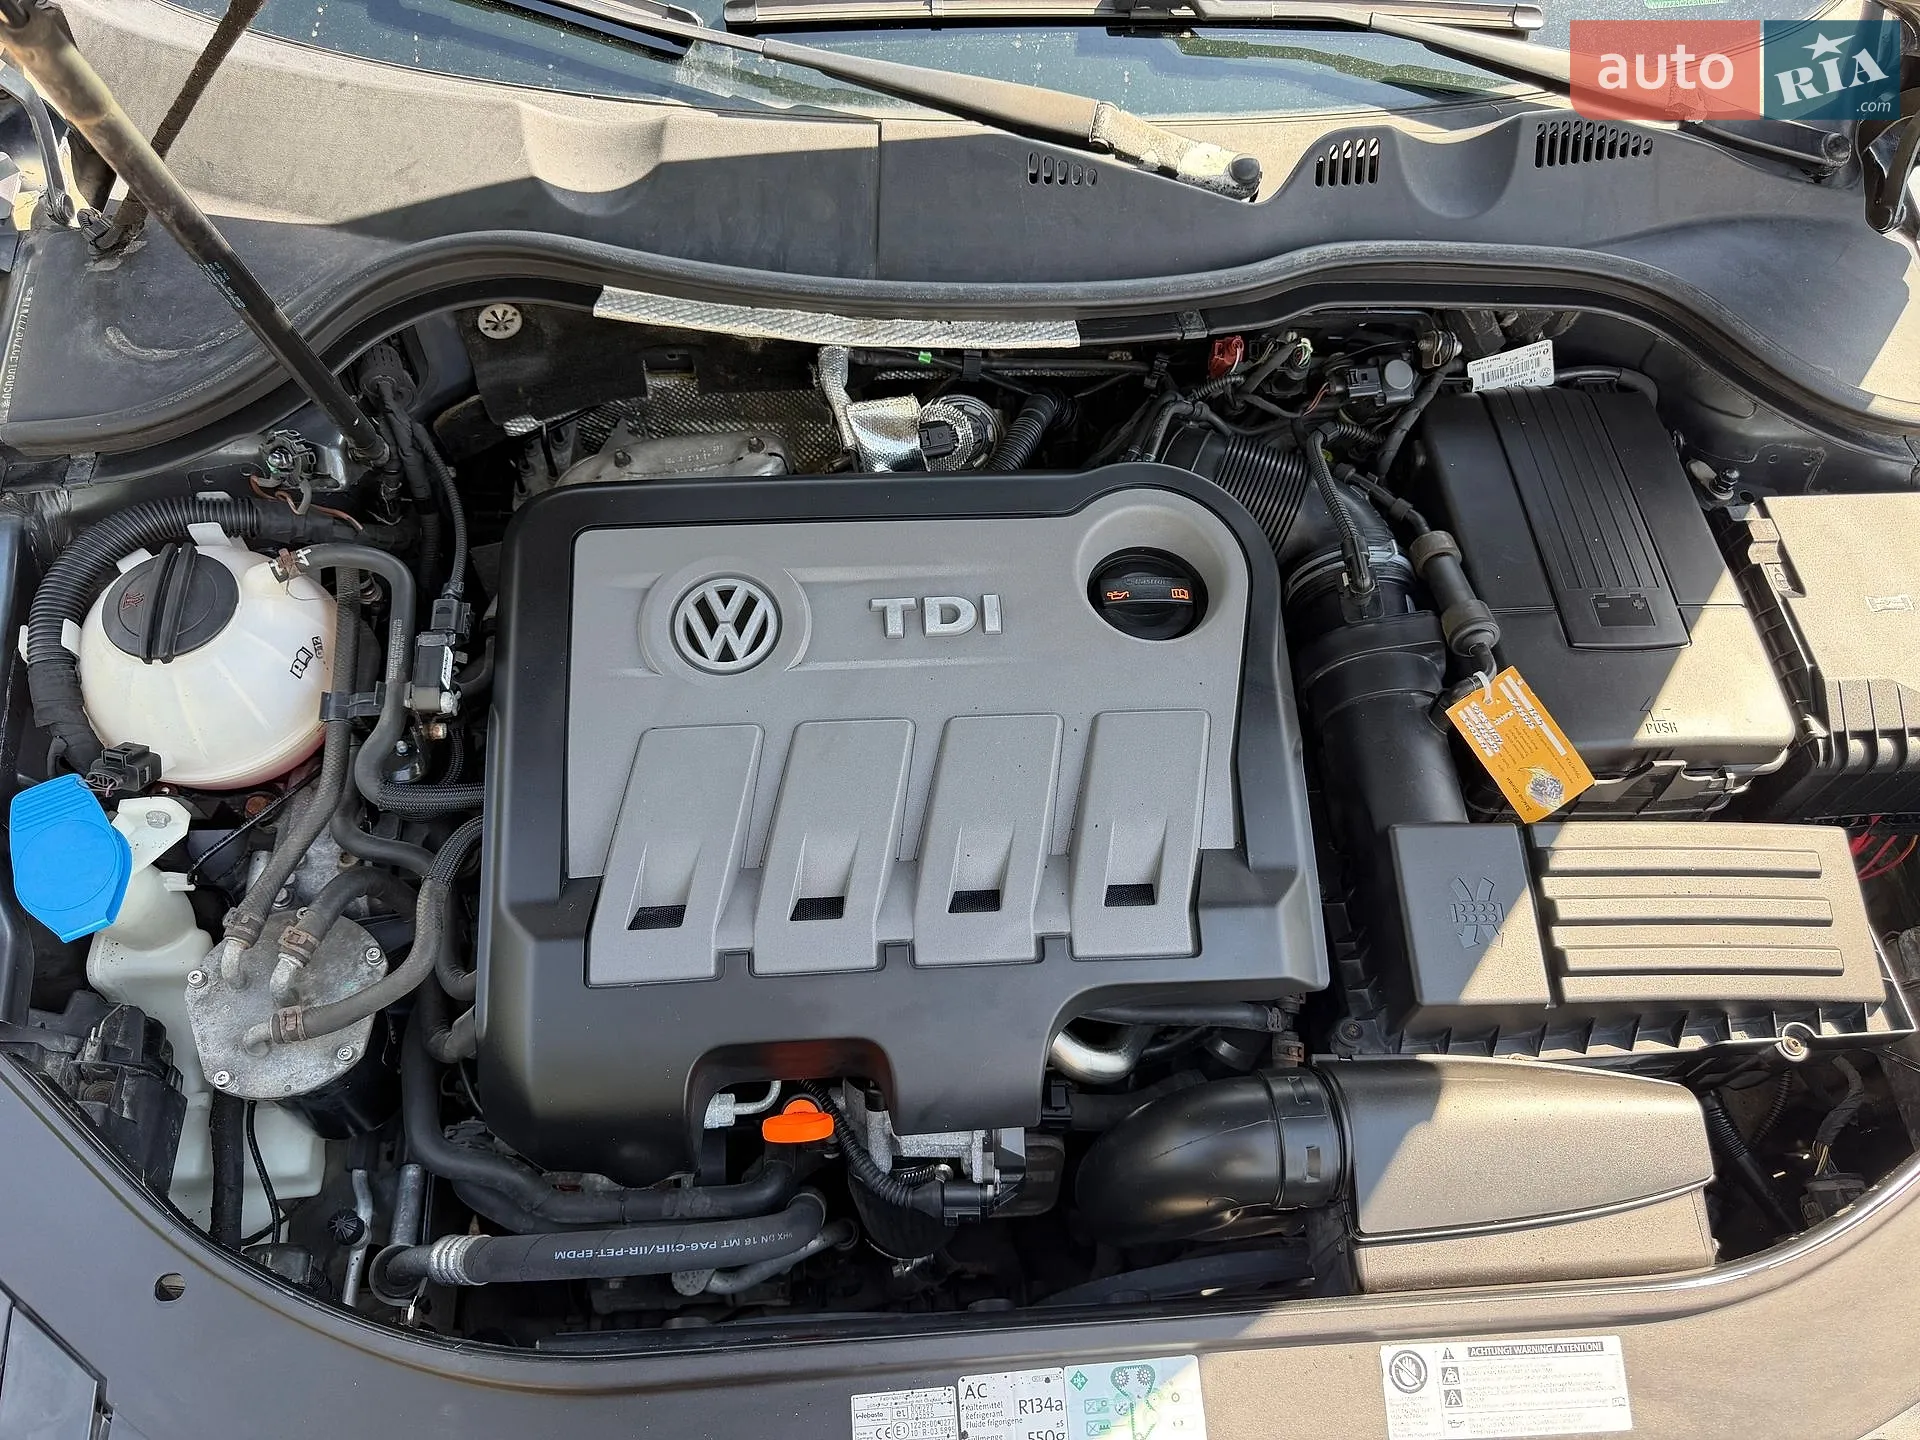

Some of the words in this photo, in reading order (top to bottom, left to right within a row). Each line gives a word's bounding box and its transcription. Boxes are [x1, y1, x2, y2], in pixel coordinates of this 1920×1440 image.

[869, 594, 1002, 638] TDI
[674, 578, 778, 671] VW
[1645, 722, 1678, 734] PUSH
[721, 1239, 741, 1249] MT
[745, 1236, 758, 1246] 16
[761, 1235, 775, 1244] DN
[1555, 1341, 1603, 1353] ATTENTION!
[965, 1383, 987, 1400] AC
[1019, 1397, 1064, 1415] R134a
[965, 1410, 1004, 1421] Refrigerant
[966, 1420, 986, 1429] Fluide
